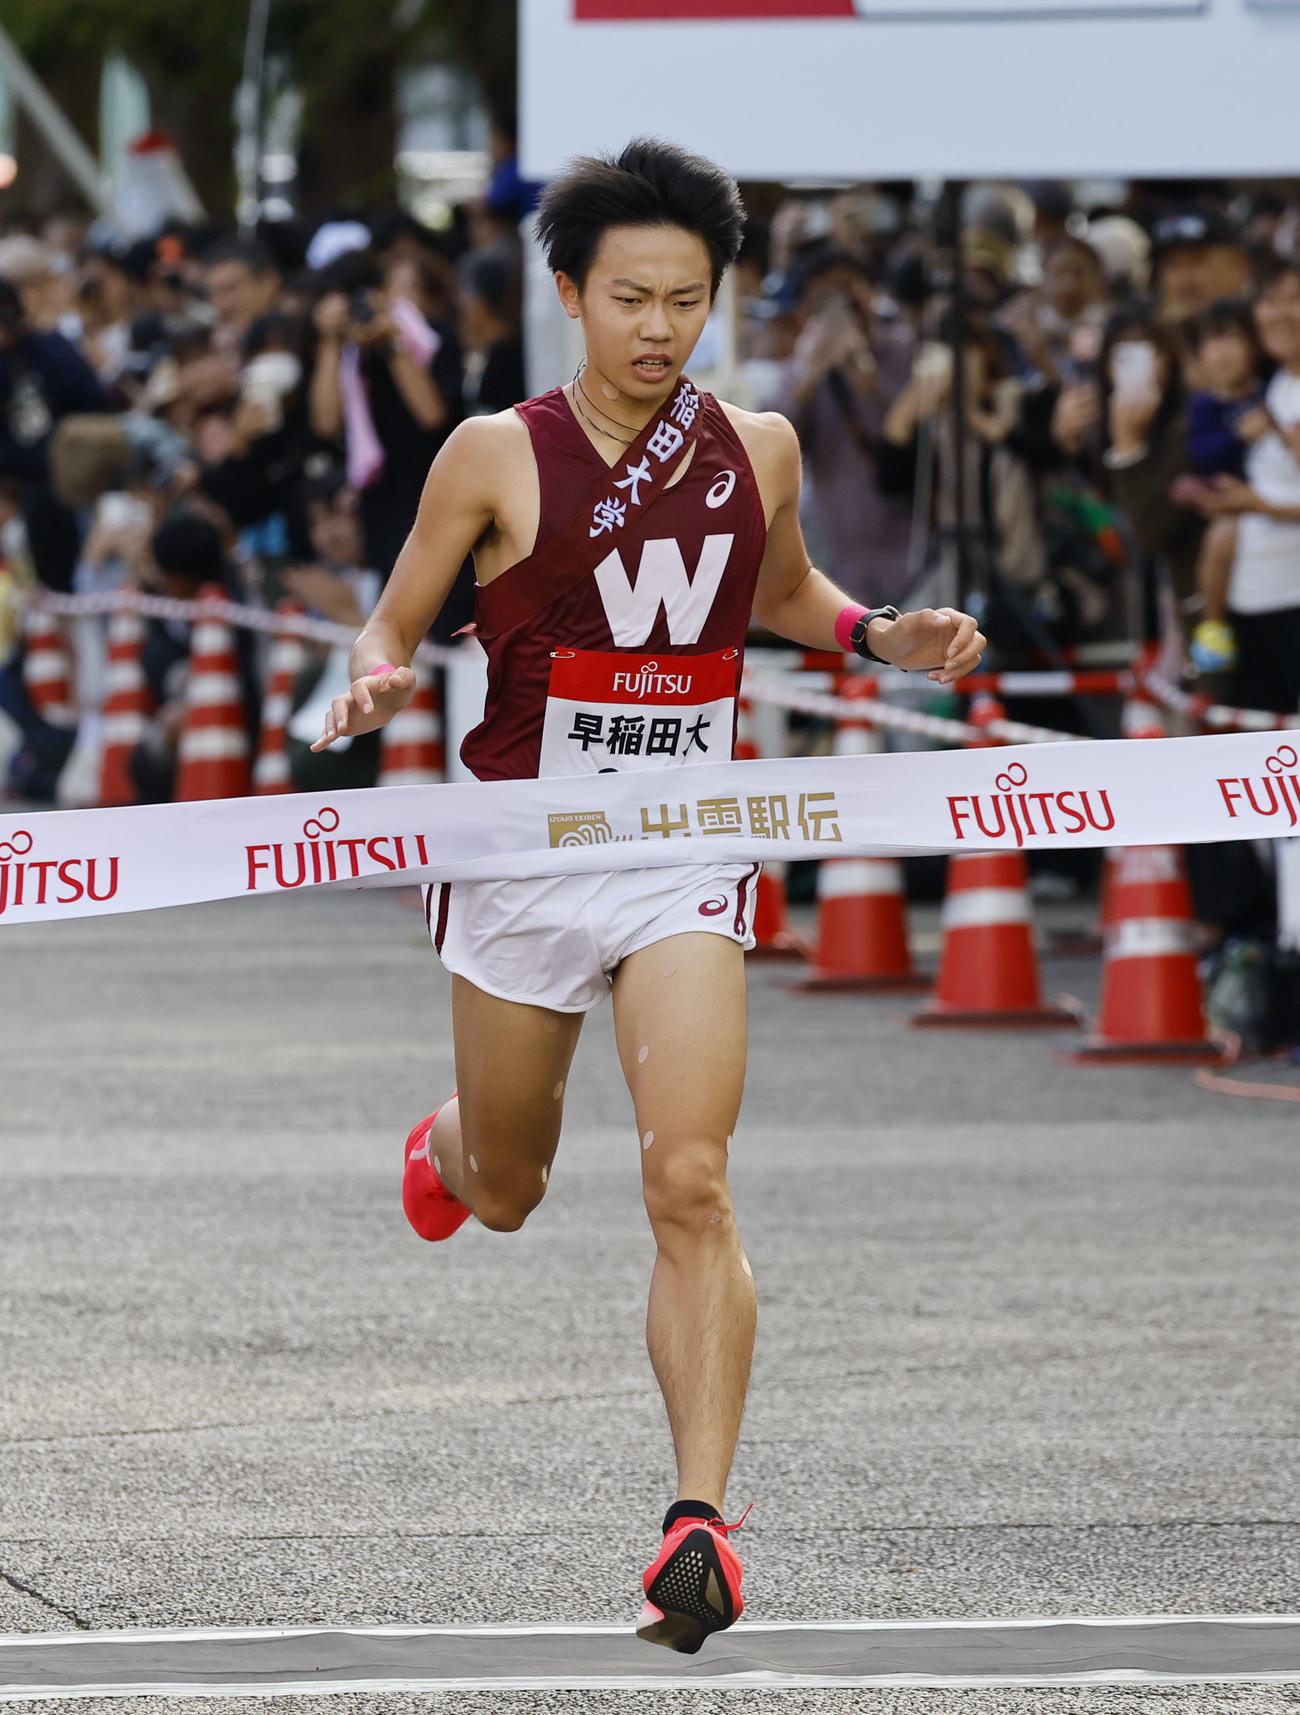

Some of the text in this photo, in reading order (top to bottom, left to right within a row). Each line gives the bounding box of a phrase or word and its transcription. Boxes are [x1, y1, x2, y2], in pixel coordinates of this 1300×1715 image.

[593, 533, 735, 648] W
[612, 671, 692, 699] FUJITSU
[567, 711, 712, 757] 早稲田大
[549, 815, 573, 823] IZUMO
[946, 789, 1115, 848] FUJITSU
